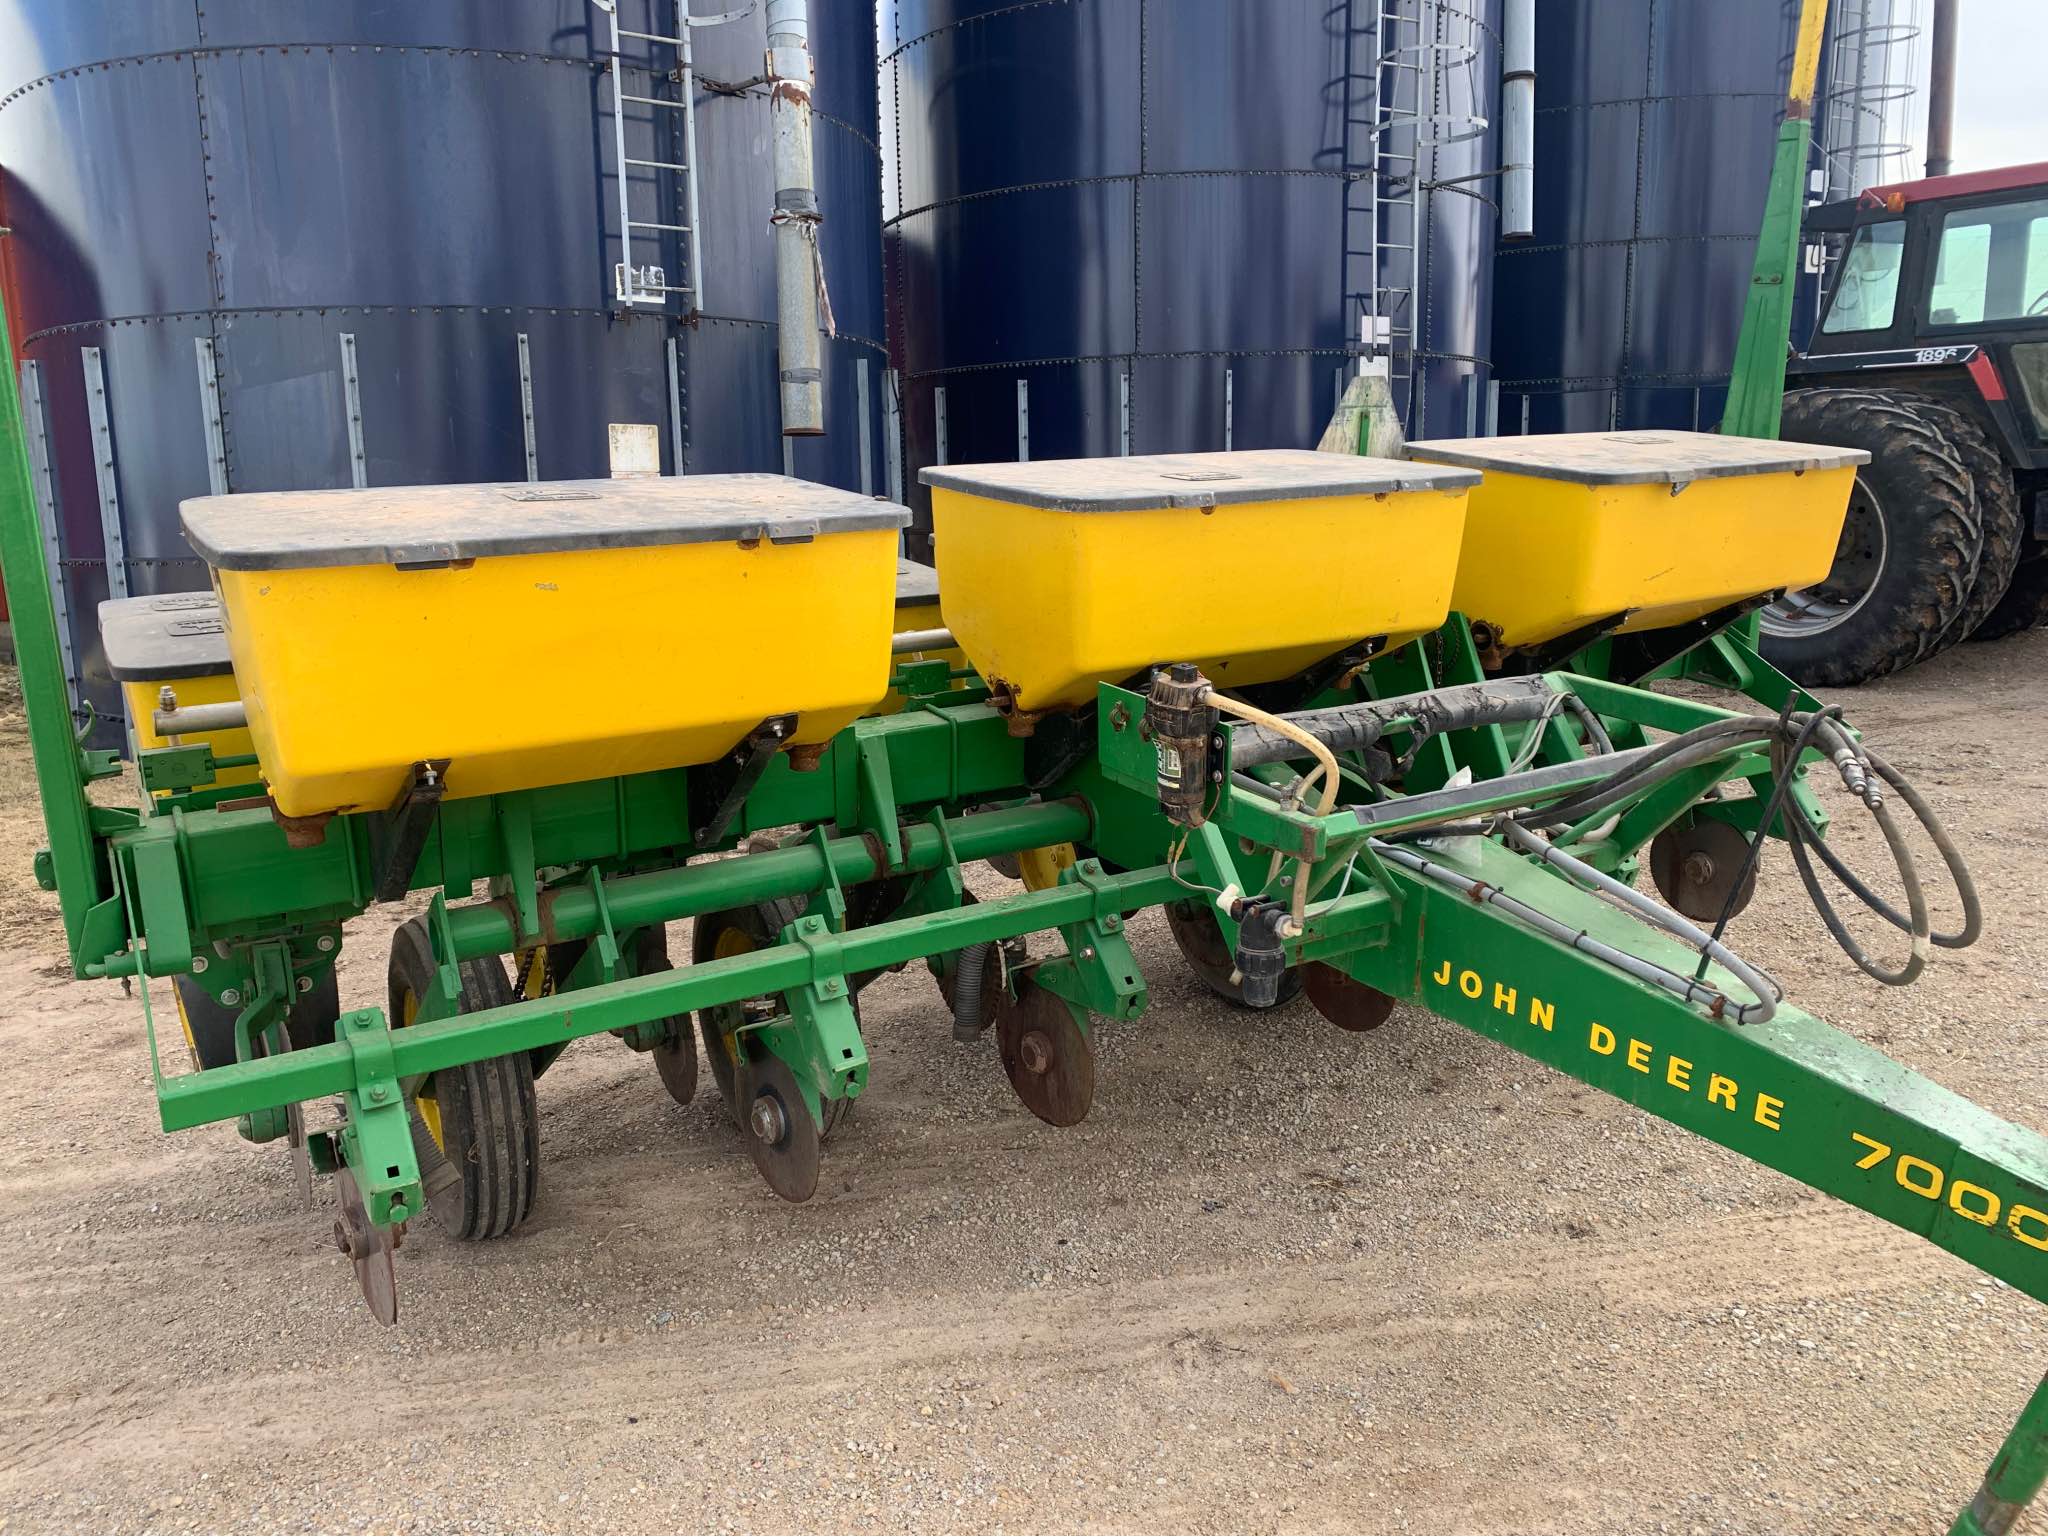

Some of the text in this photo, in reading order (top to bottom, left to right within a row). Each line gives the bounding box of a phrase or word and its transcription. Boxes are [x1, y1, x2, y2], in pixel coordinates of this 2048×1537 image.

[1433, 960, 2048, 1252] JOHN DEERE 7000
